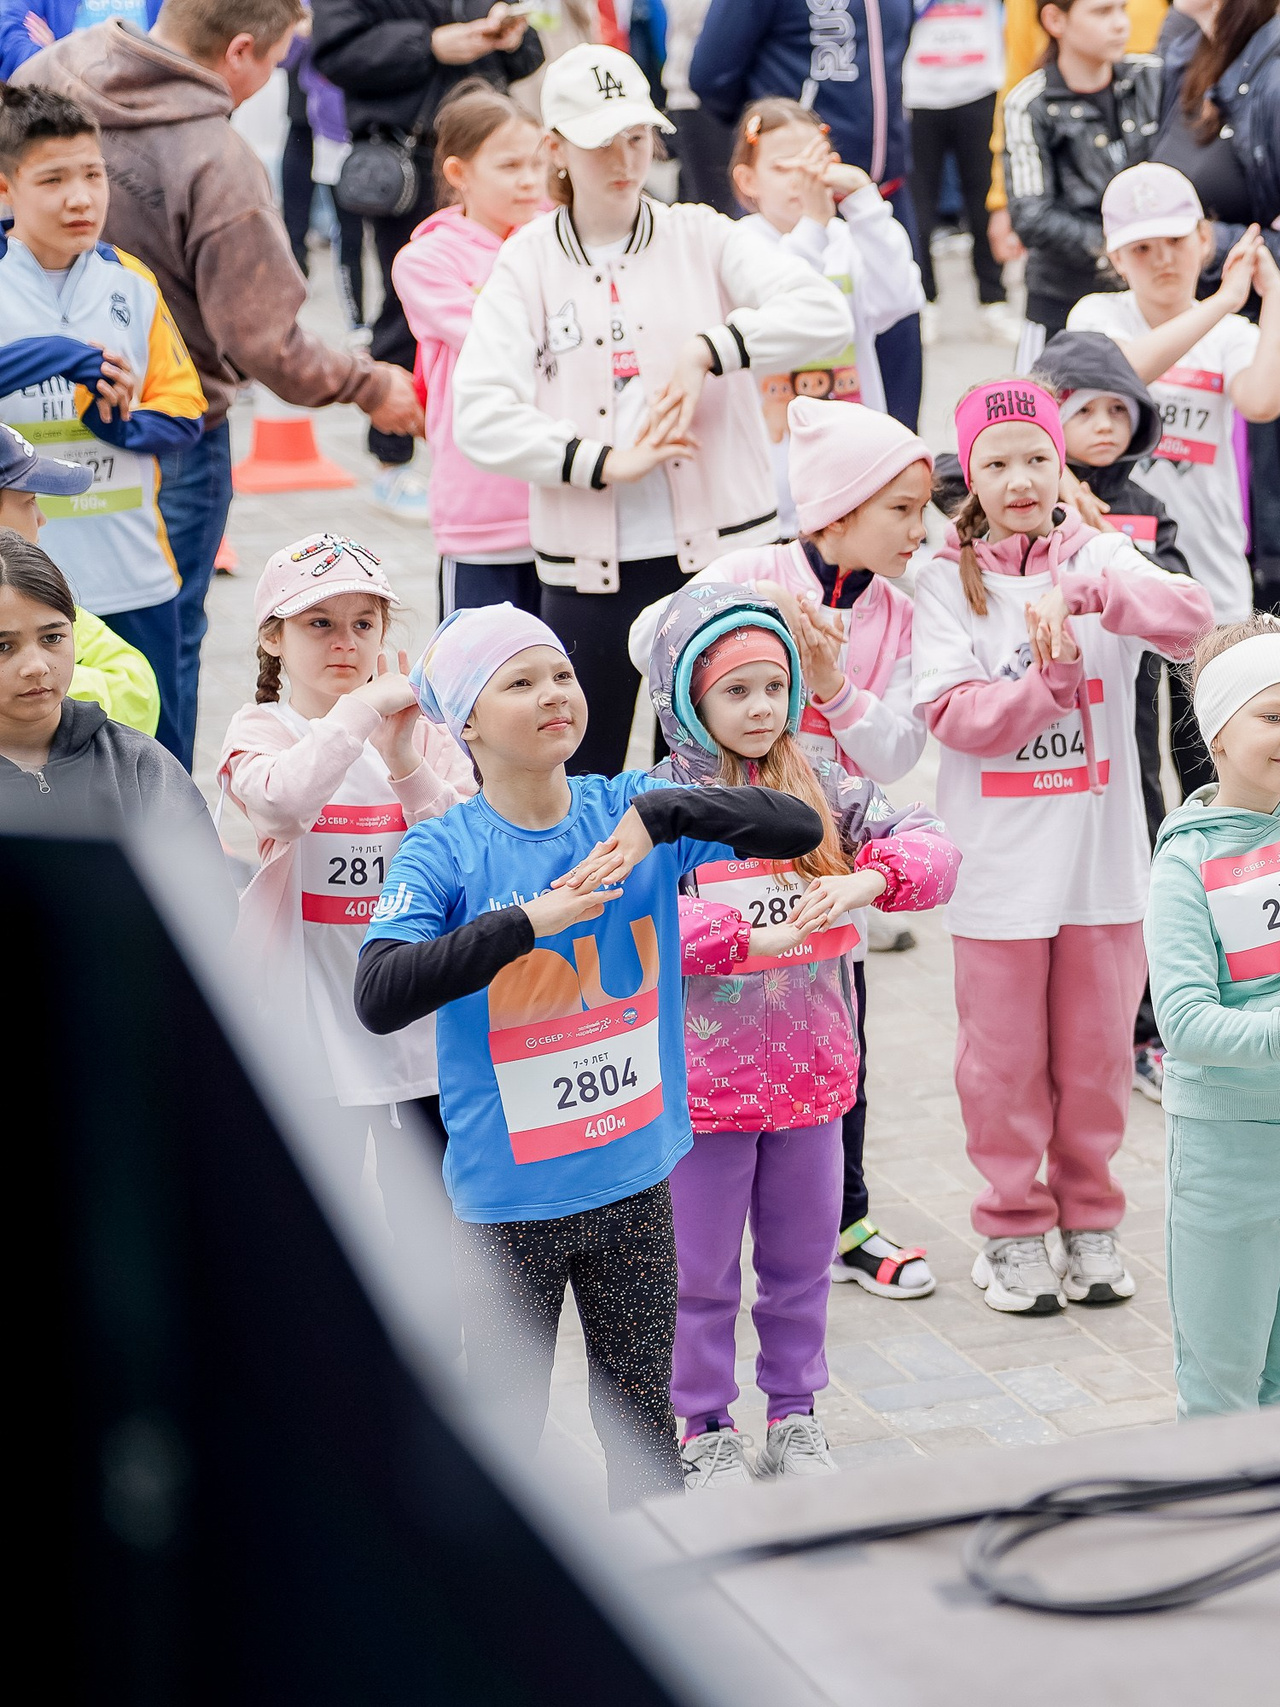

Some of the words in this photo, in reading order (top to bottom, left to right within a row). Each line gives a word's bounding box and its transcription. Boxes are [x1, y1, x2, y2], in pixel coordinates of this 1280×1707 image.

[591, 66, 625, 99] LA
[1155, 403, 1209, 431] 817
[1033, 772, 1074, 790] 400м
[328, 817, 348, 826] СБЕР
[365, 845, 383, 853] ЛЕТ
[738, 861, 760, 871] СБЕР
[1243, 860, 1266, 873] СБЕР
[766, 886, 780, 894] 7-9
[782, 883, 799, 892] ЛЕТ
[710, 919, 722, 937] TR
[684, 942, 697, 959] TR
[740, 1016, 756, 1026] TR
[792, 1020, 809, 1031] TR
[538, 1033, 564, 1045] СБЕР
[715, 1038, 730, 1047] TR
[816, 1035, 830, 1046] TR
[771, 1042, 787, 1052] TR
[573, 1058, 589, 1069] 7-9
[592, 1052, 609, 1064] ЛЕТ
[691, 1056, 706, 1067] TR
[738, 1055, 755, 1065] TR
[832, 1053, 844, 1065] TR
[792, 1063, 809, 1073] TR
[553, 1057, 638, 1110] 2804
[712, 1077, 730, 1088] TR
[772, 1083, 788, 1094] TR
[692, 1097, 709, 1107] TR
[741, 1094, 758, 1105] TR
[816, 1114, 829, 1125] TR
[585, 1114, 626, 1138] 400м
